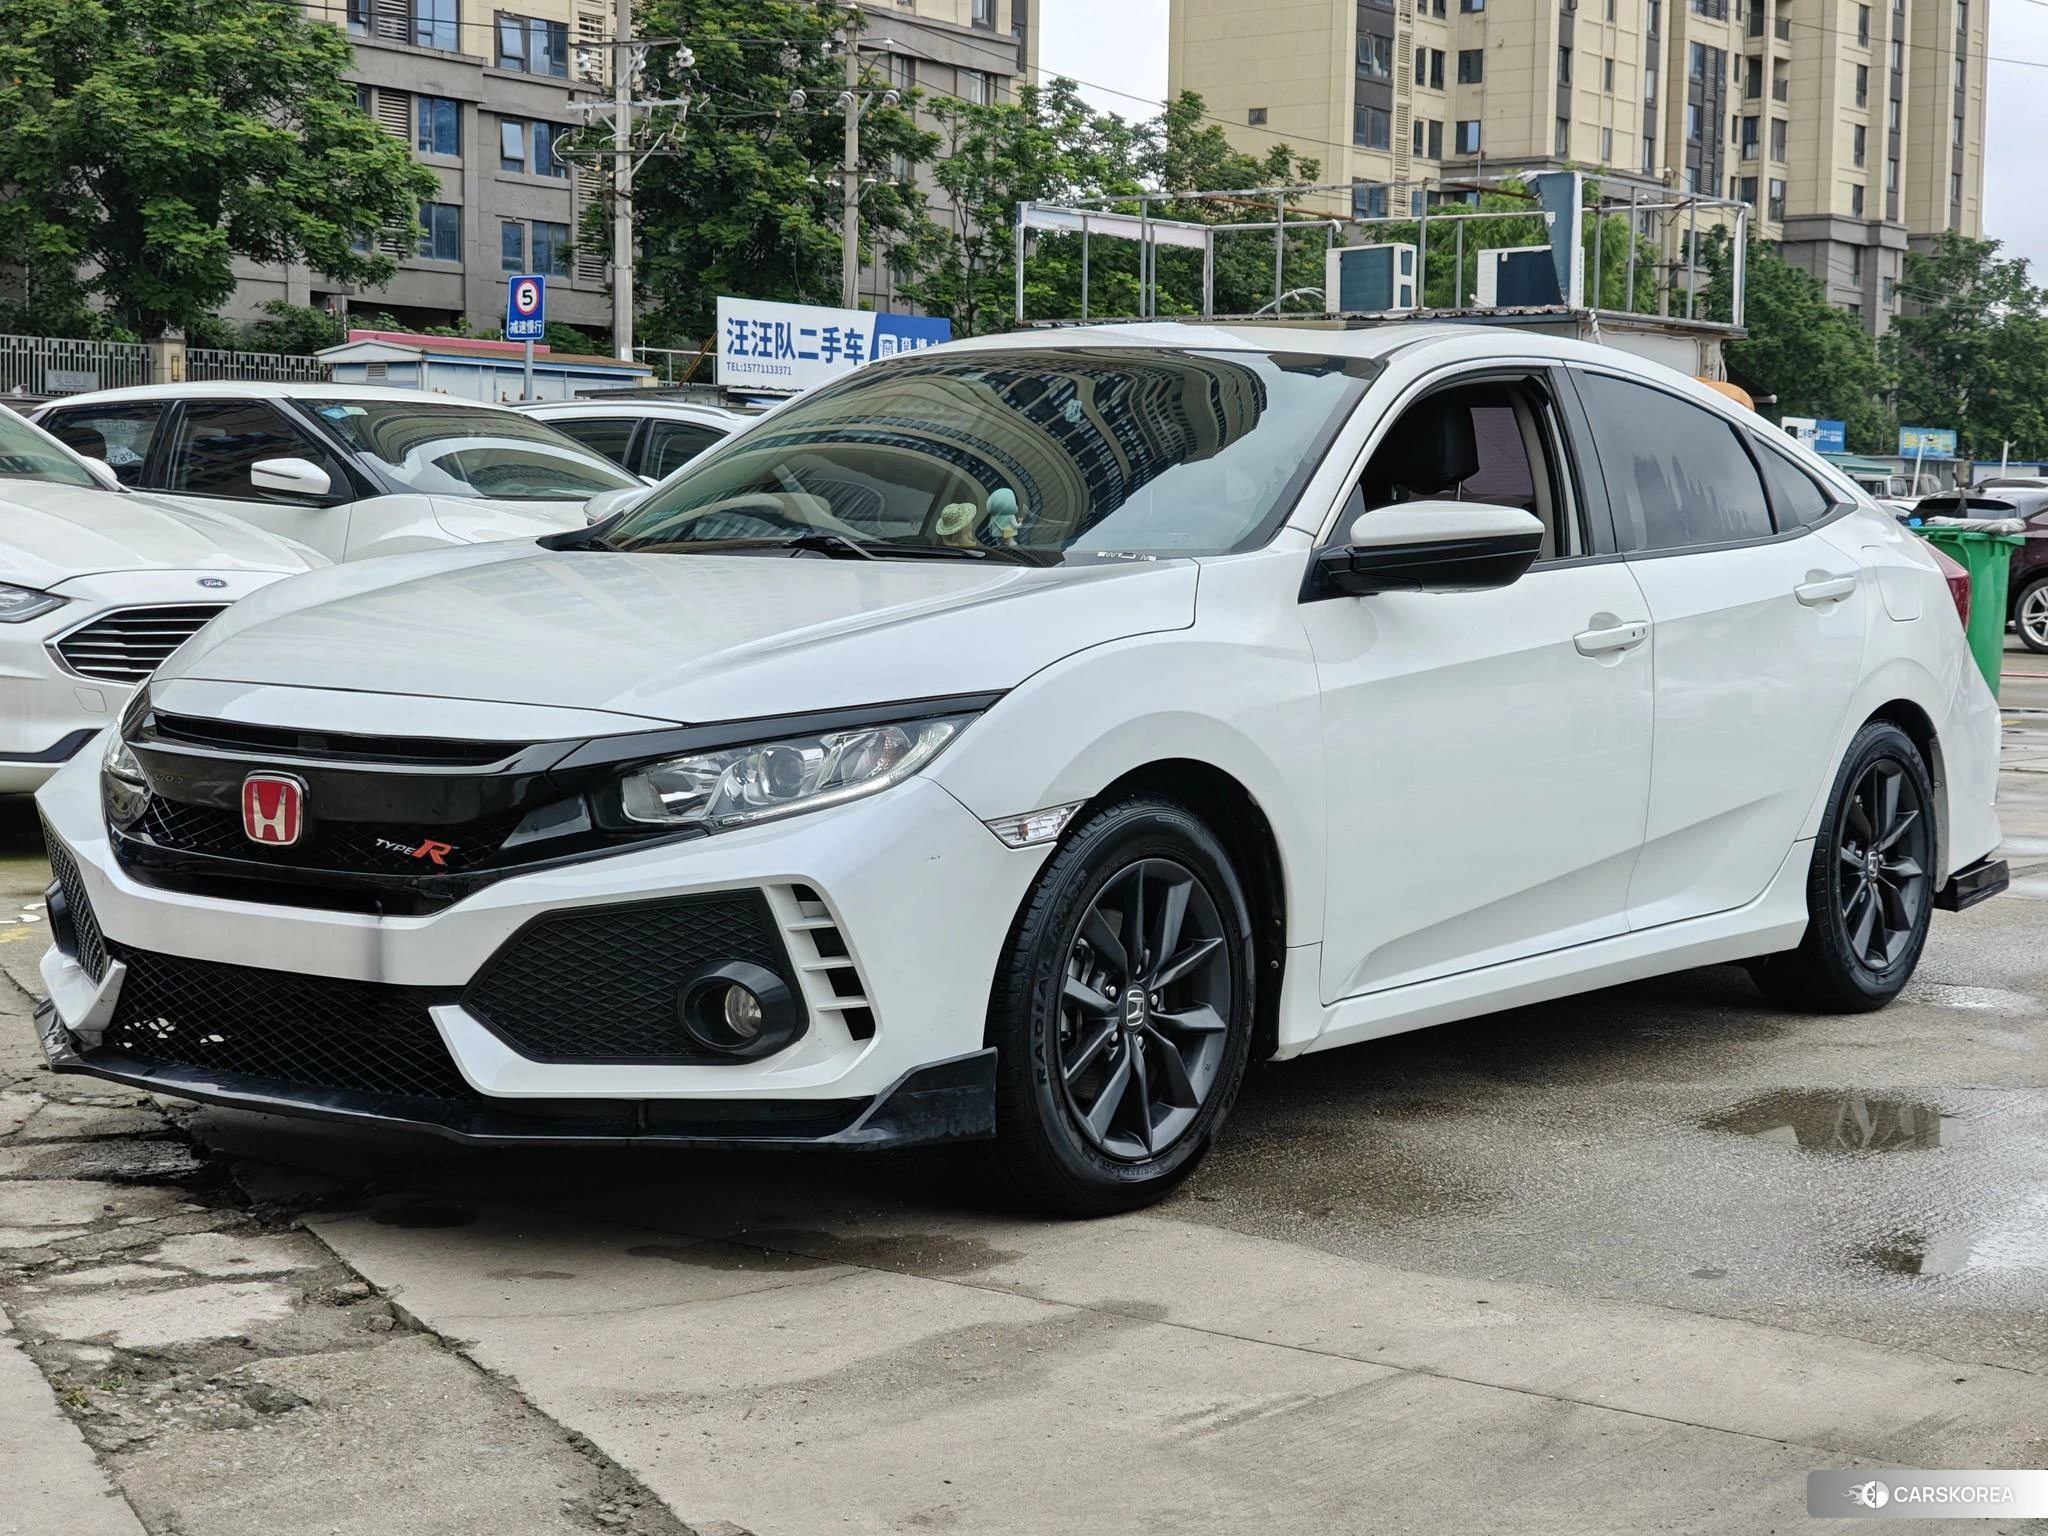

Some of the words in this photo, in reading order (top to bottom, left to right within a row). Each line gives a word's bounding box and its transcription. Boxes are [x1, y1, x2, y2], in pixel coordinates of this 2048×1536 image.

[521, 289, 533, 306] 5
[726, 317, 865, 366] 汪汪队二手车
[726, 361, 792, 376] TEL:15771133371
[375, 838, 417, 856] TYPE
[412, 838, 452, 866] R
